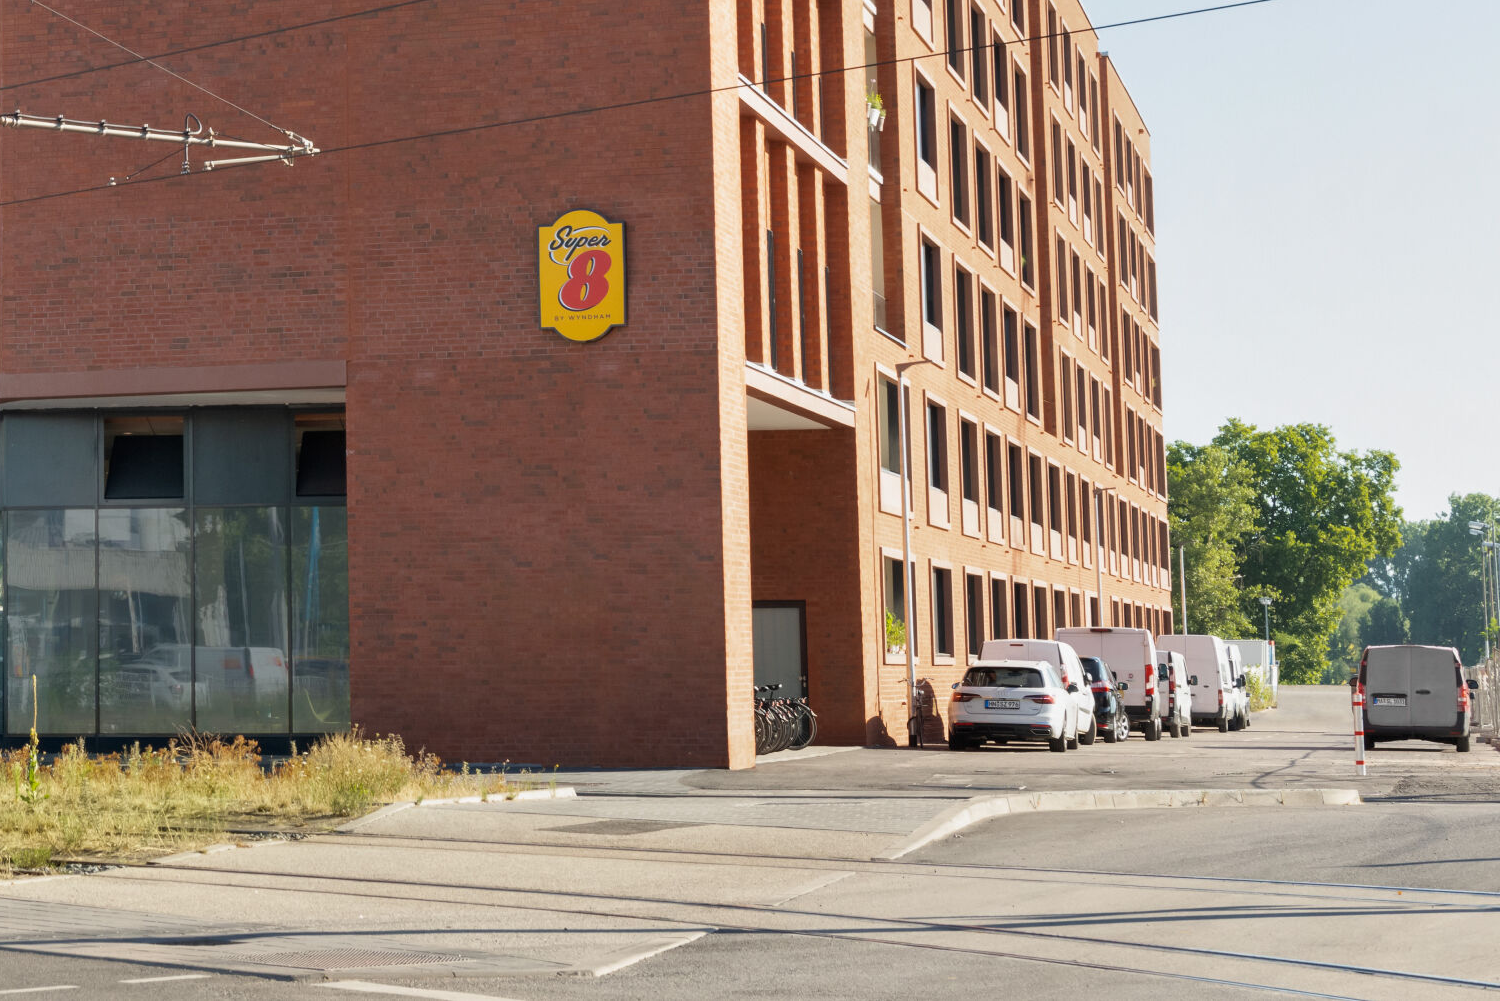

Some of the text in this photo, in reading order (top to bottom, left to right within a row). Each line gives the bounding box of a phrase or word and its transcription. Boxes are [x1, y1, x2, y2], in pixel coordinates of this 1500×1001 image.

[548, 225, 611, 262] Super
[558, 249, 612, 312] 8
[568, 313, 612, 321] WYNDHAM
